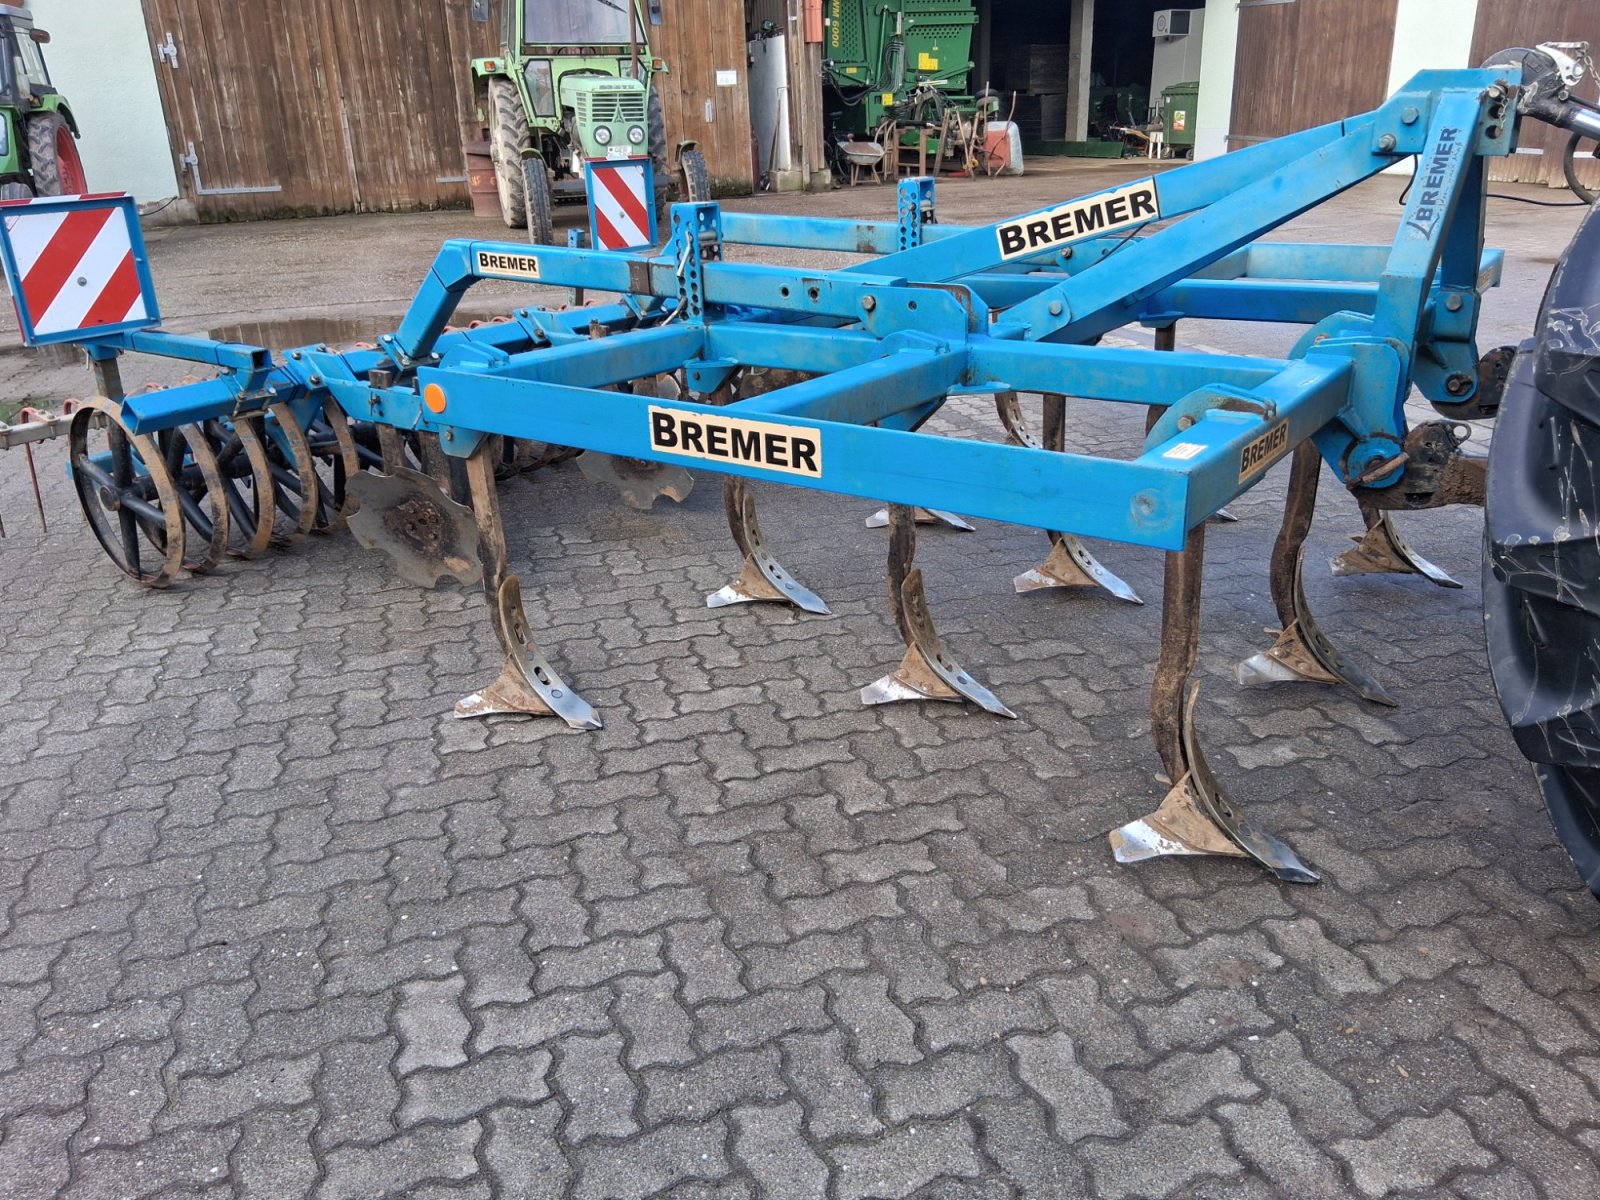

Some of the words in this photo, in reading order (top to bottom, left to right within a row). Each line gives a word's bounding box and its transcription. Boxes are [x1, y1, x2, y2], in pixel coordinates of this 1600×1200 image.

[832, 20, 840, 48] 6000
[1416, 128, 1457, 221] BREMER
[999, 189, 1156, 256] BREMER
[479, 253, 537, 272] BREMER
[652, 412, 818, 472] BREMER
[1240, 423, 1287, 474] BREMER
